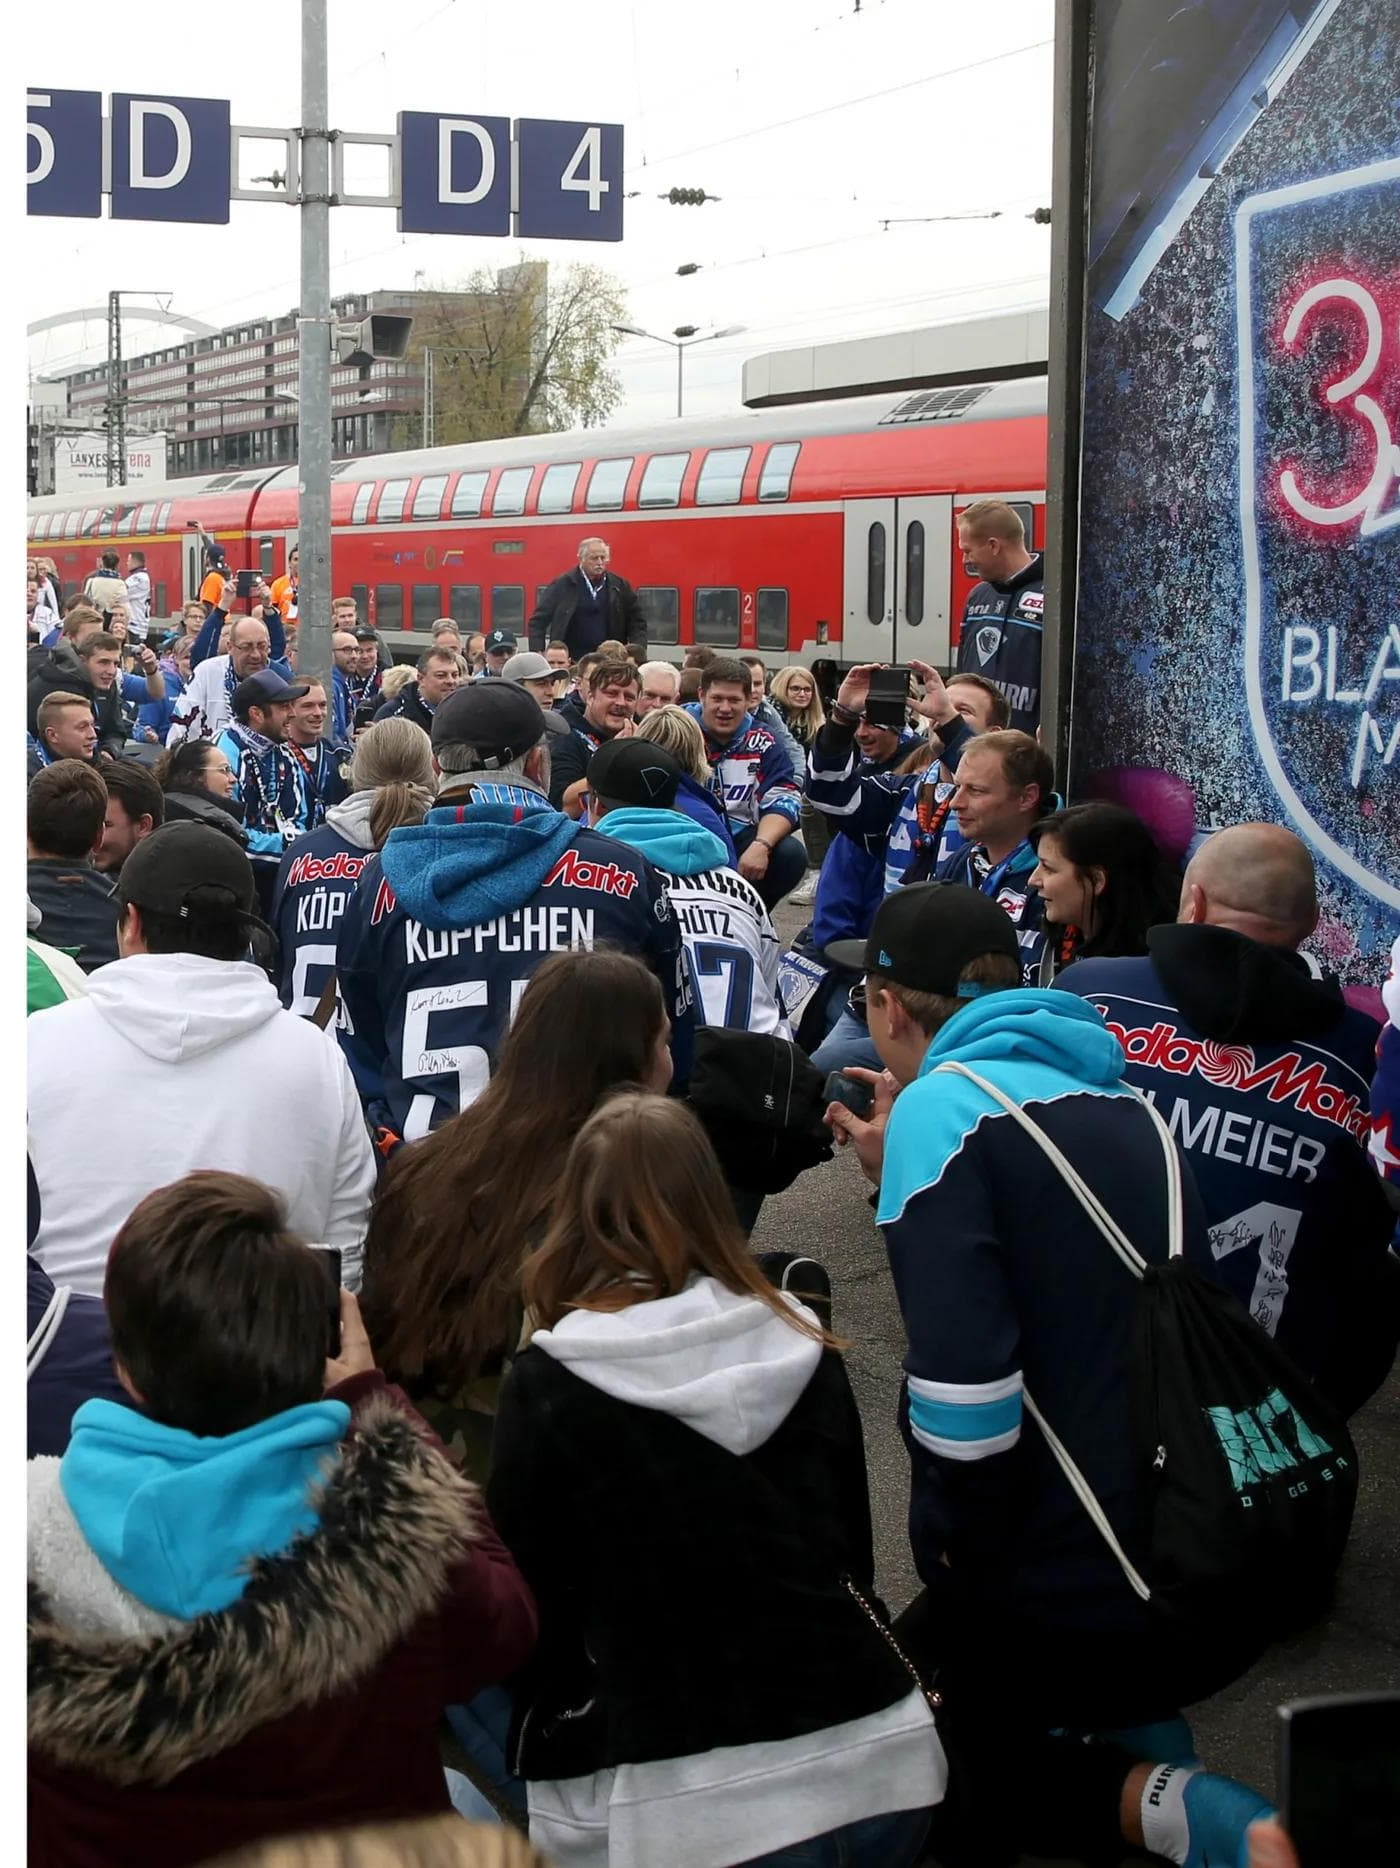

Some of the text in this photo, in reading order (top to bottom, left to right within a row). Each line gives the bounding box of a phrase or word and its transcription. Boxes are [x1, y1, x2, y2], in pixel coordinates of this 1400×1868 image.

[27, 95, 193, 190] 5 D
[437, 118, 610, 212] D 4
[368, 588, 375, 604] 2
[744, 594, 752, 614] 2
[284, 852, 366, 889] Media
[542, 849, 639, 900] Markt
[296, 886, 352, 933] KÖP
[677, 905, 735, 939] HÜTZ
[1096, 1005, 1202, 1076] dia
[1152, 1090, 1327, 1184] MEIER
[1148, 1764, 1180, 1807] pum
